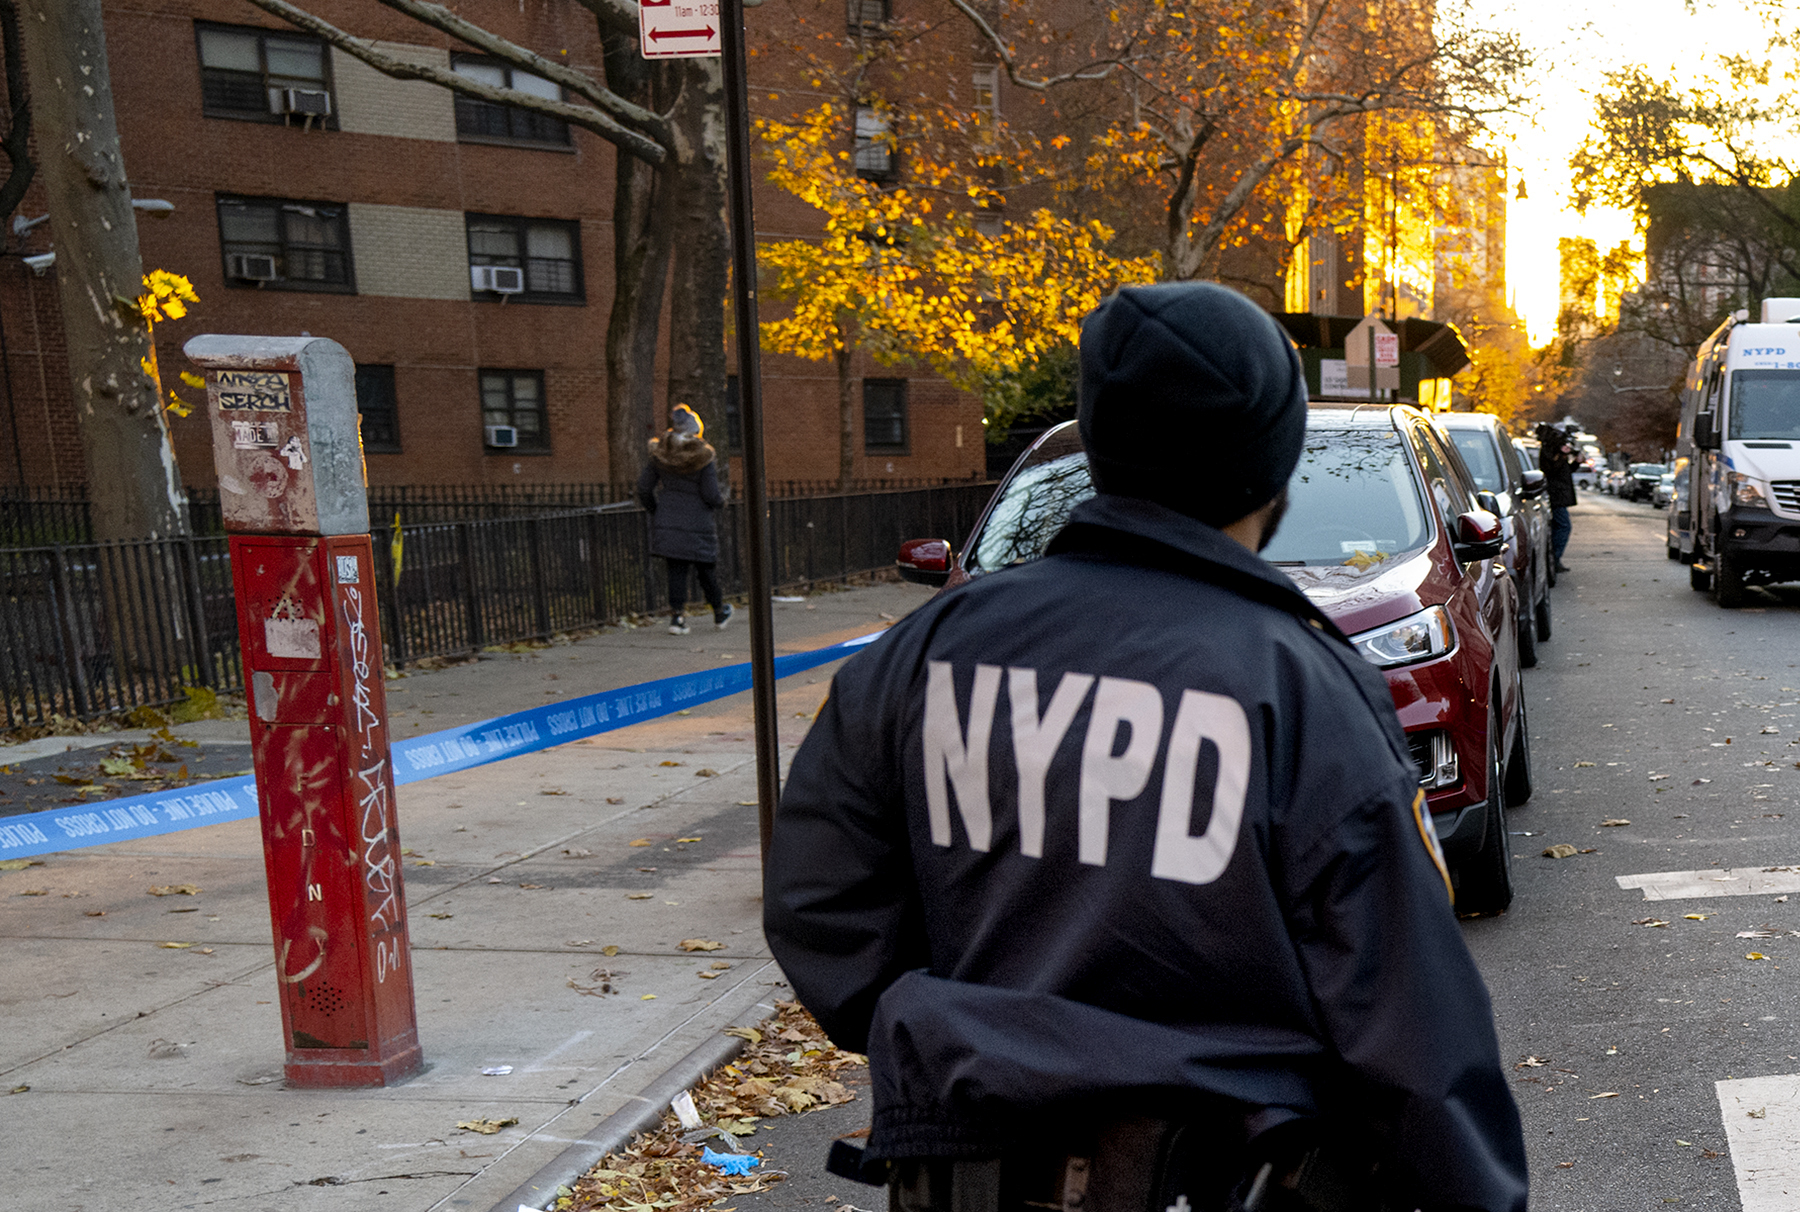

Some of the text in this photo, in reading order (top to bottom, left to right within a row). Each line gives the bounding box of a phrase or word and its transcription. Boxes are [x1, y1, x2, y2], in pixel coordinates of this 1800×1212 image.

[674, 6, 694, 17] 11am
[1742, 348, 1786, 357] NYPD
[923, 659, 1251, 885] NYPD
[128, 804, 159, 826] DO
[156, 796, 196, 821] LINE
[193, 790, 239, 817] POLICE
[54, 812, 110, 838] CROSS
[105, 807, 139, 831] NOT
